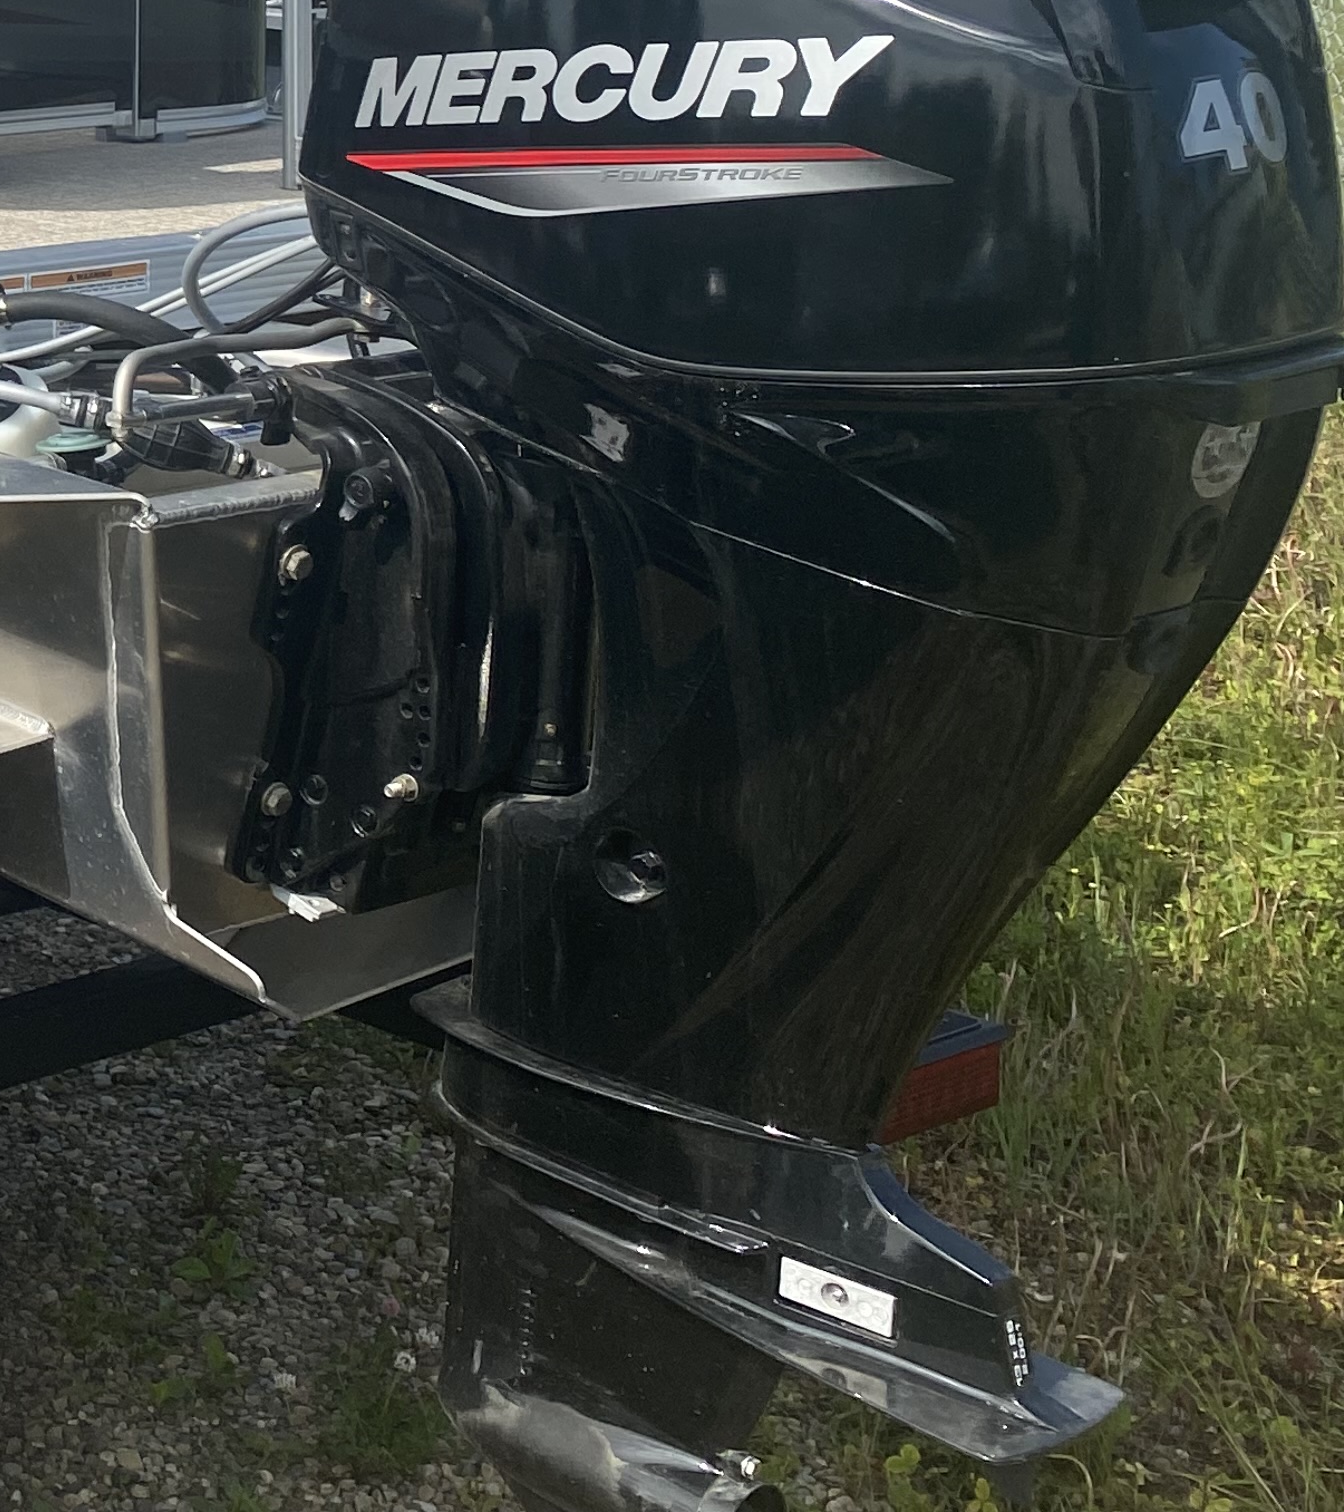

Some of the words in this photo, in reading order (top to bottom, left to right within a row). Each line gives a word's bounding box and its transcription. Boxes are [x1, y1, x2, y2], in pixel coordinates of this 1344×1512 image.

[354, 34, 894, 129] MERCURY
[1177, 68, 1287, 175] 40
[599, 166, 805, 184] FOURSTROKE
